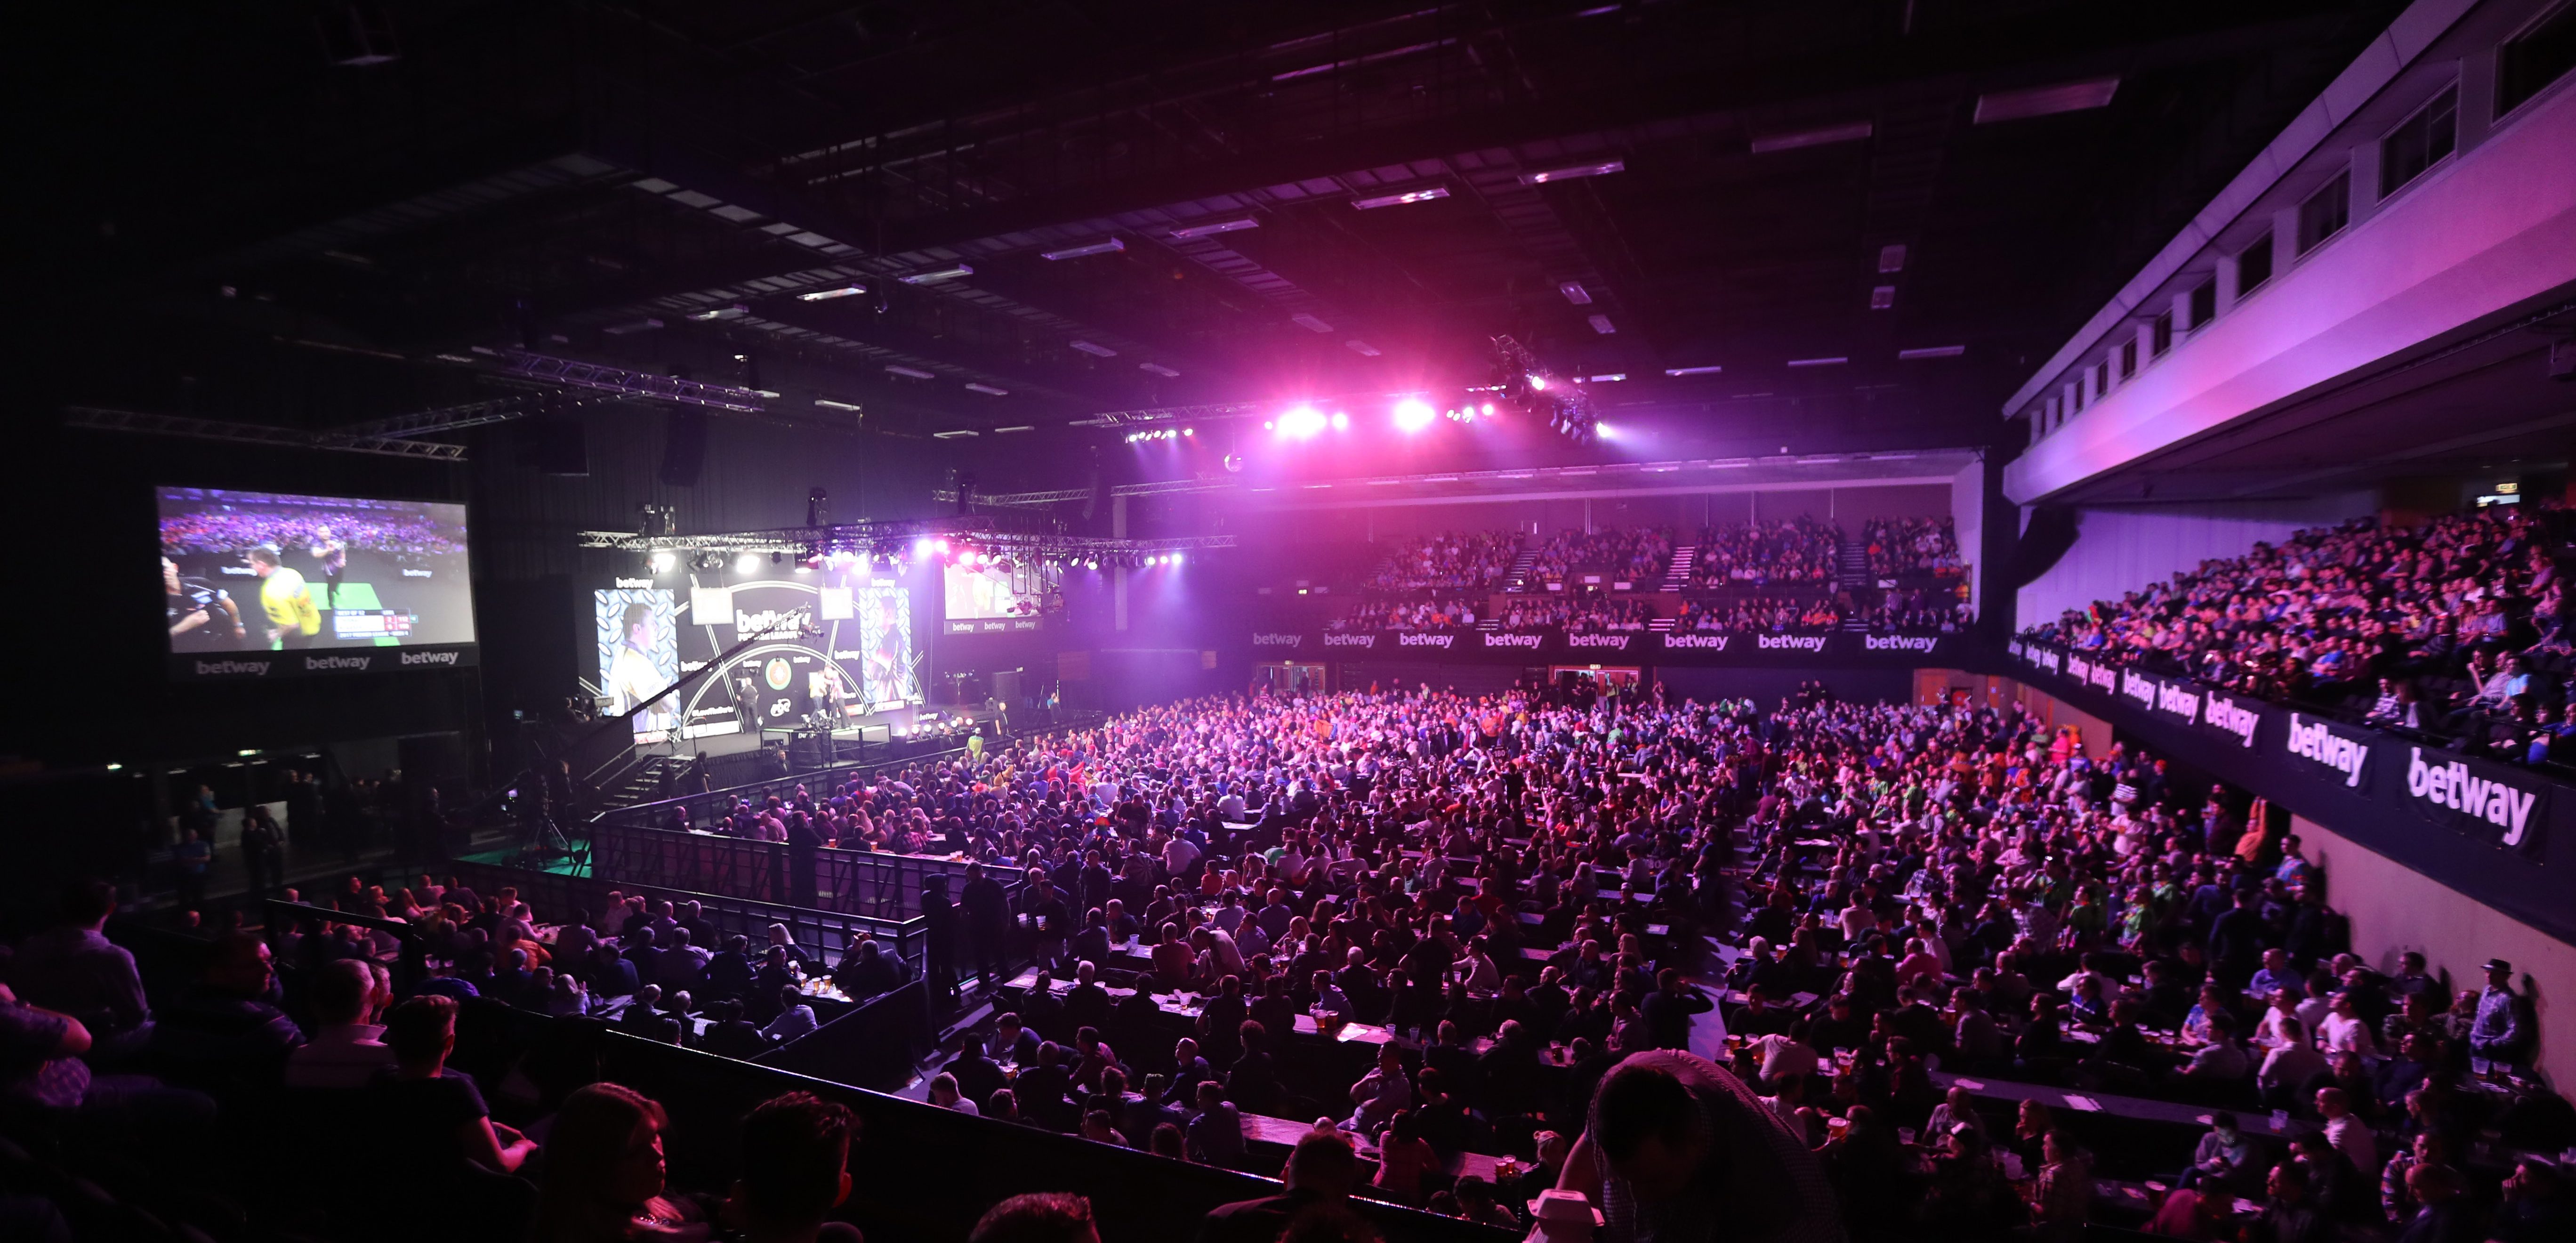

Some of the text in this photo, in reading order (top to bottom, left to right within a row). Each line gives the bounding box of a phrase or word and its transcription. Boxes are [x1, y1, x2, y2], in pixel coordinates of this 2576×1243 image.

[402, 569, 432, 578] betway
[616, 577, 653, 590] betway
[953, 621, 1036, 632] betway betway betway
[1254, 633, 1937, 653] betway betway betway betway betway betway betway betway
[196, 651, 459, 675] betway betway betway
[919, 712, 938, 721] betway
[2067, 652, 2089, 686] betway
[2091, 660, 2117, 695] betway
[2123, 668, 2156, 710] betway
[2159, 680, 2199, 725] betway
[2205, 690, 2259, 748] betway
[2287, 712, 2368, 787] betway
[2407, 747, 2536, 846] betway
